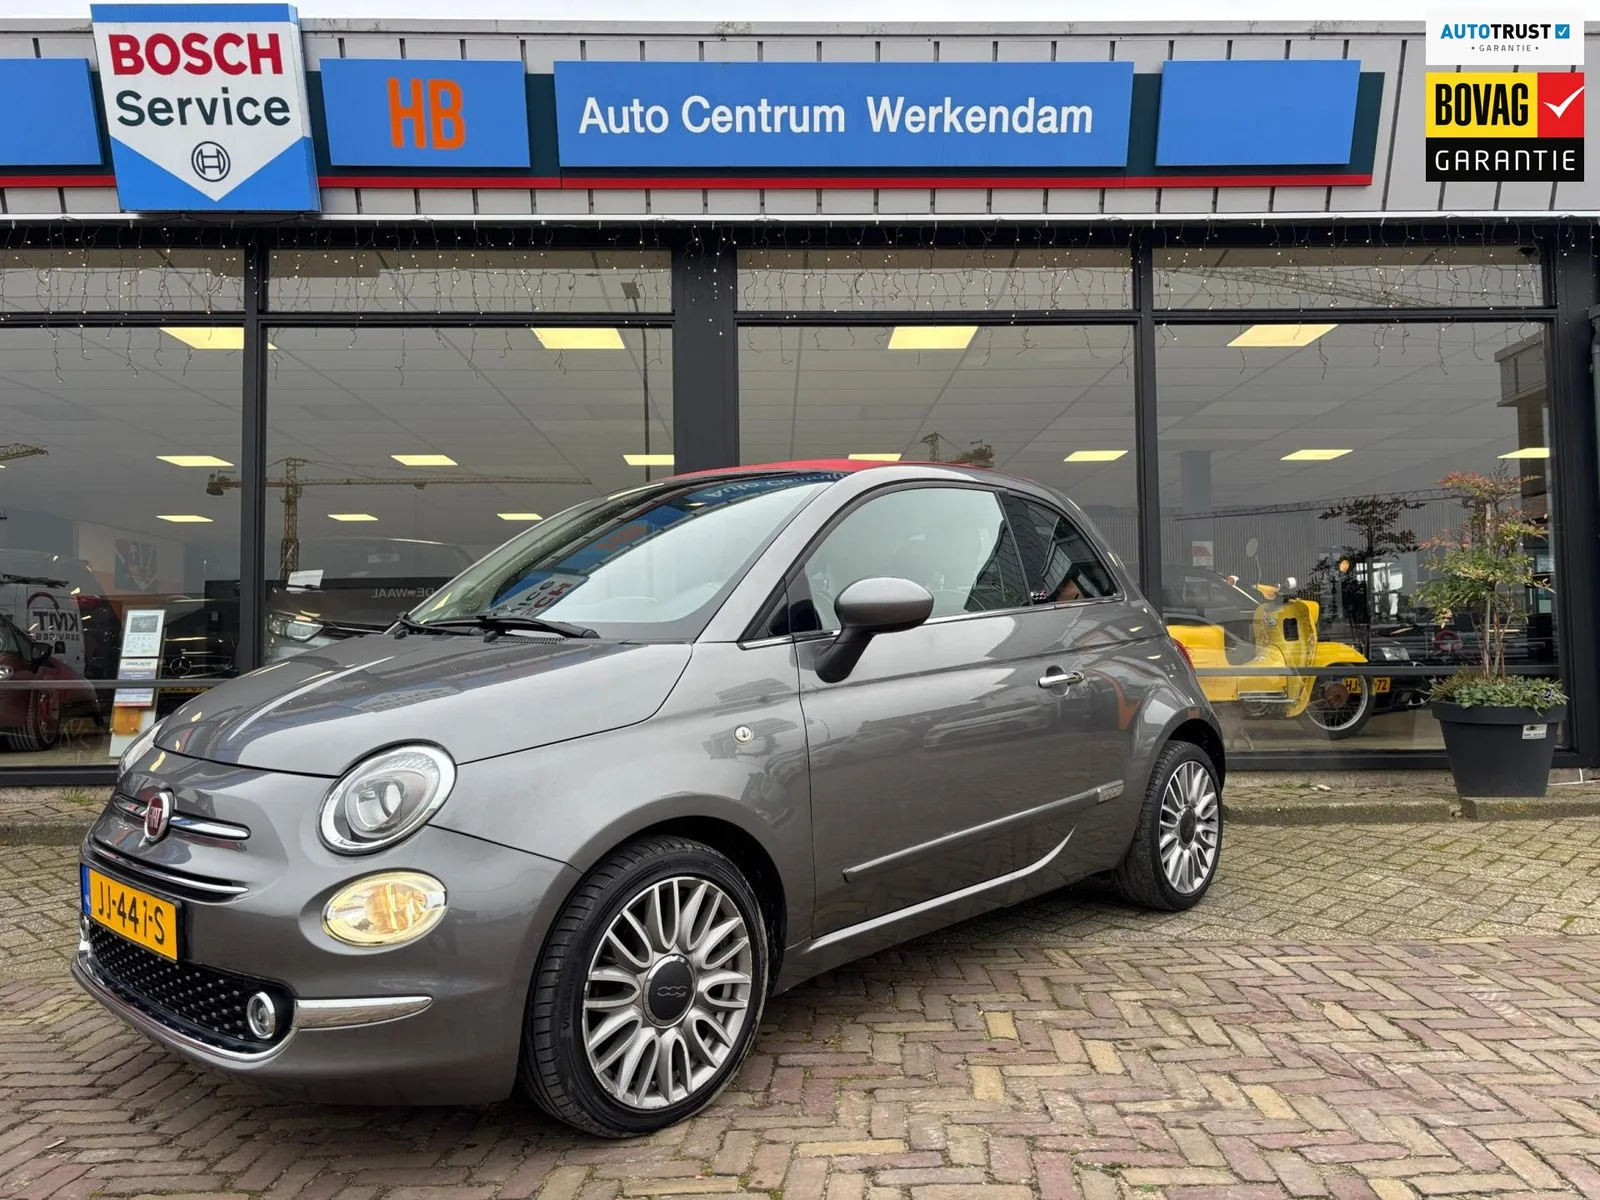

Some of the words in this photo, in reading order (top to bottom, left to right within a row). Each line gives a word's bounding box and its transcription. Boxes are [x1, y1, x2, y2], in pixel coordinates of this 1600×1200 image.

[108, 32, 284, 76] BOSCH
[115, 86, 291, 127] Service
[387, 76, 467, 151] HB
[578, 96, 670, 134] Auto
[681, 95, 846, 134] Centrum
[866, 96, 1093, 134] Werkendam
[1345, 678, 1388, 692] HJ--72
[98, 881, 165, 945] JJ-441-S
